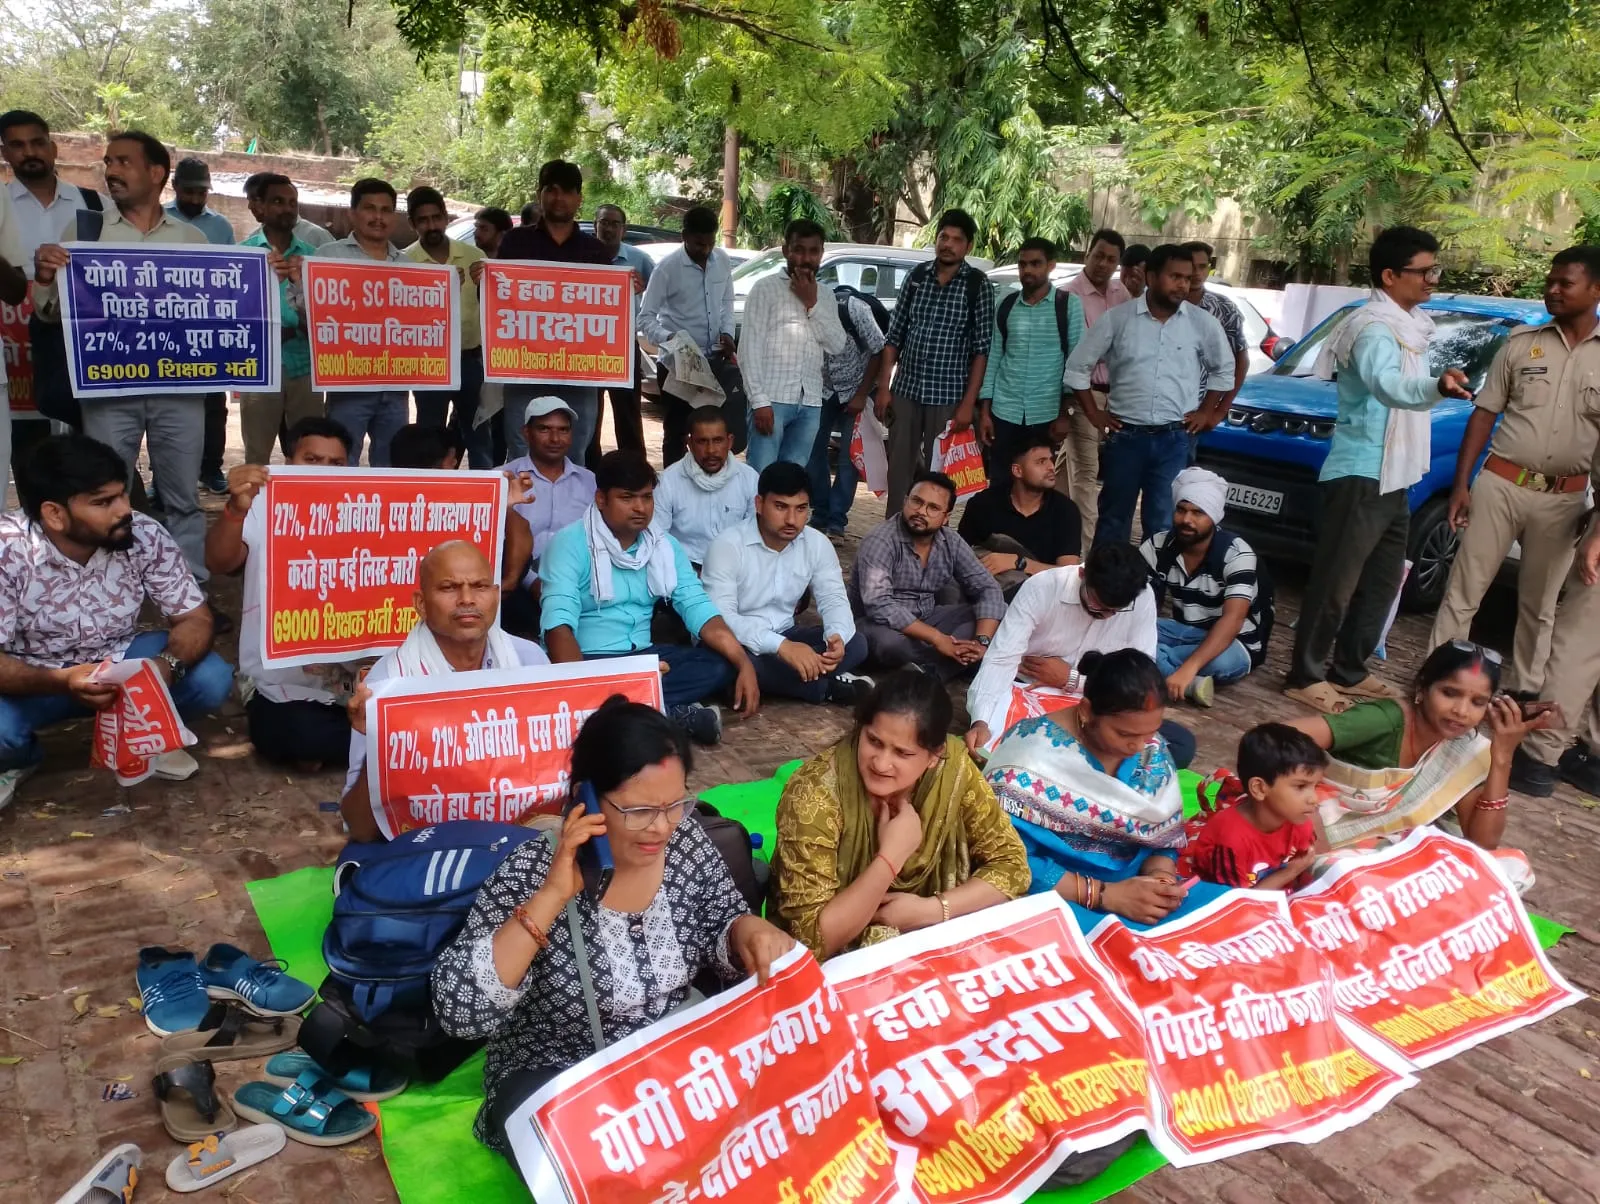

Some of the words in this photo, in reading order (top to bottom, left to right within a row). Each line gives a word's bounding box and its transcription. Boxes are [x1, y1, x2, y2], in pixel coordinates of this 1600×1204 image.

[84, 260, 127, 288] योगी
[134, 261, 157, 288] जी
[163, 267, 205, 288] न्याय
[210, 263, 249, 293] करों,
[313, 277, 356, 311] OBC,
[362, 280, 384, 308] SC
[388, 278, 446, 309] शिक्षकों
[491, 271, 514, 301] है
[518, 279, 557, 303] हक
[561, 281, 622, 306] हमारा
[102, 293, 148, 325] पिछड़े
[154, 293, 209, 320] दलितों
[214, 299, 237, 319] का
[496, 308, 619, 344] आरक्षण
[84, 332, 130, 354] 27%,
[136, 332, 180, 353] 21%,
[185, 329, 213, 356] पूरा
[316, 317, 339, 345] को
[343, 324, 382, 346] न्याय
[384, 317, 446, 347] दिलाओं
[87, 363, 150, 380] 69000
[157, 358, 218, 378] शिक्षक
[225, 358, 258, 378] भर्ती
[318, 353, 345, 376] 69000
[346, 350, 372, 376] शिक्षक
[373, 350, 390, 376] भर्ती
[390, 357, 420, 376] आरक्षण
[420, 351, 447, 376] घोटाला
[490, 347, 519, 369] 69000
[521, 345, 548, 370] शिक्षक
[548, 347, 567, 371] भर्ती
[567, 354, 597, 373] आरक्षण
[597, 350, 625, 374] घोटाला
[273, 502, 305, 540] 27%,
[308, 502, 334, 536] 21%
[389, 502, 409, 532] एस
[410, 494, 426, 532] सी
[427, 502, 471, 532] आरक्षण
[472, 502, 491, 543] पूरा
[1226, 486, 1281, 511] 2LE6229
[288, 550, 317, 590] करते
[317, 558, 337, 601] हुए
[339, 547, 358, 592] नई
[360, 549, 389, 587] लिस्ट
[390, 547, 416, 585] जारी
[273, 608, 319, 643] 69000
[323, 602, 365, 641] शिक्षक
[367, 598, 394, 635] भर्ती
[389, 731, 428, 775] 27%,
[432, 726, 463, 768] 21%
[527, 714, 551, 752] एस
[553, 701, 572, 750] सी
[408, 784, 445, 823] करते
[1354, 885, 1396, 931] की
[1388, 860, 1463, 918] सरकार
[1442, 903, 1510, 961] कतार
[864, 978, 951, 1042] हक
[947, 943, 1077, 1014] हमारा
[871, 989, 1122, 1137] आरक्षण
[589, 1077, 686, 1175] योगी
[675, 1045, 739, 1122] की
[785, 1049, 863, 1137] कतार
[1172, 1082, 1235, 1137] 69000
[1224, 1068, 1291, 1125] शिक्षक
[914, 1140, 985, 1196] 69000
[955, 1099, 1036, 1174] शिक्षक
[1051, 1064, 1132, 1118] आरक्षण
